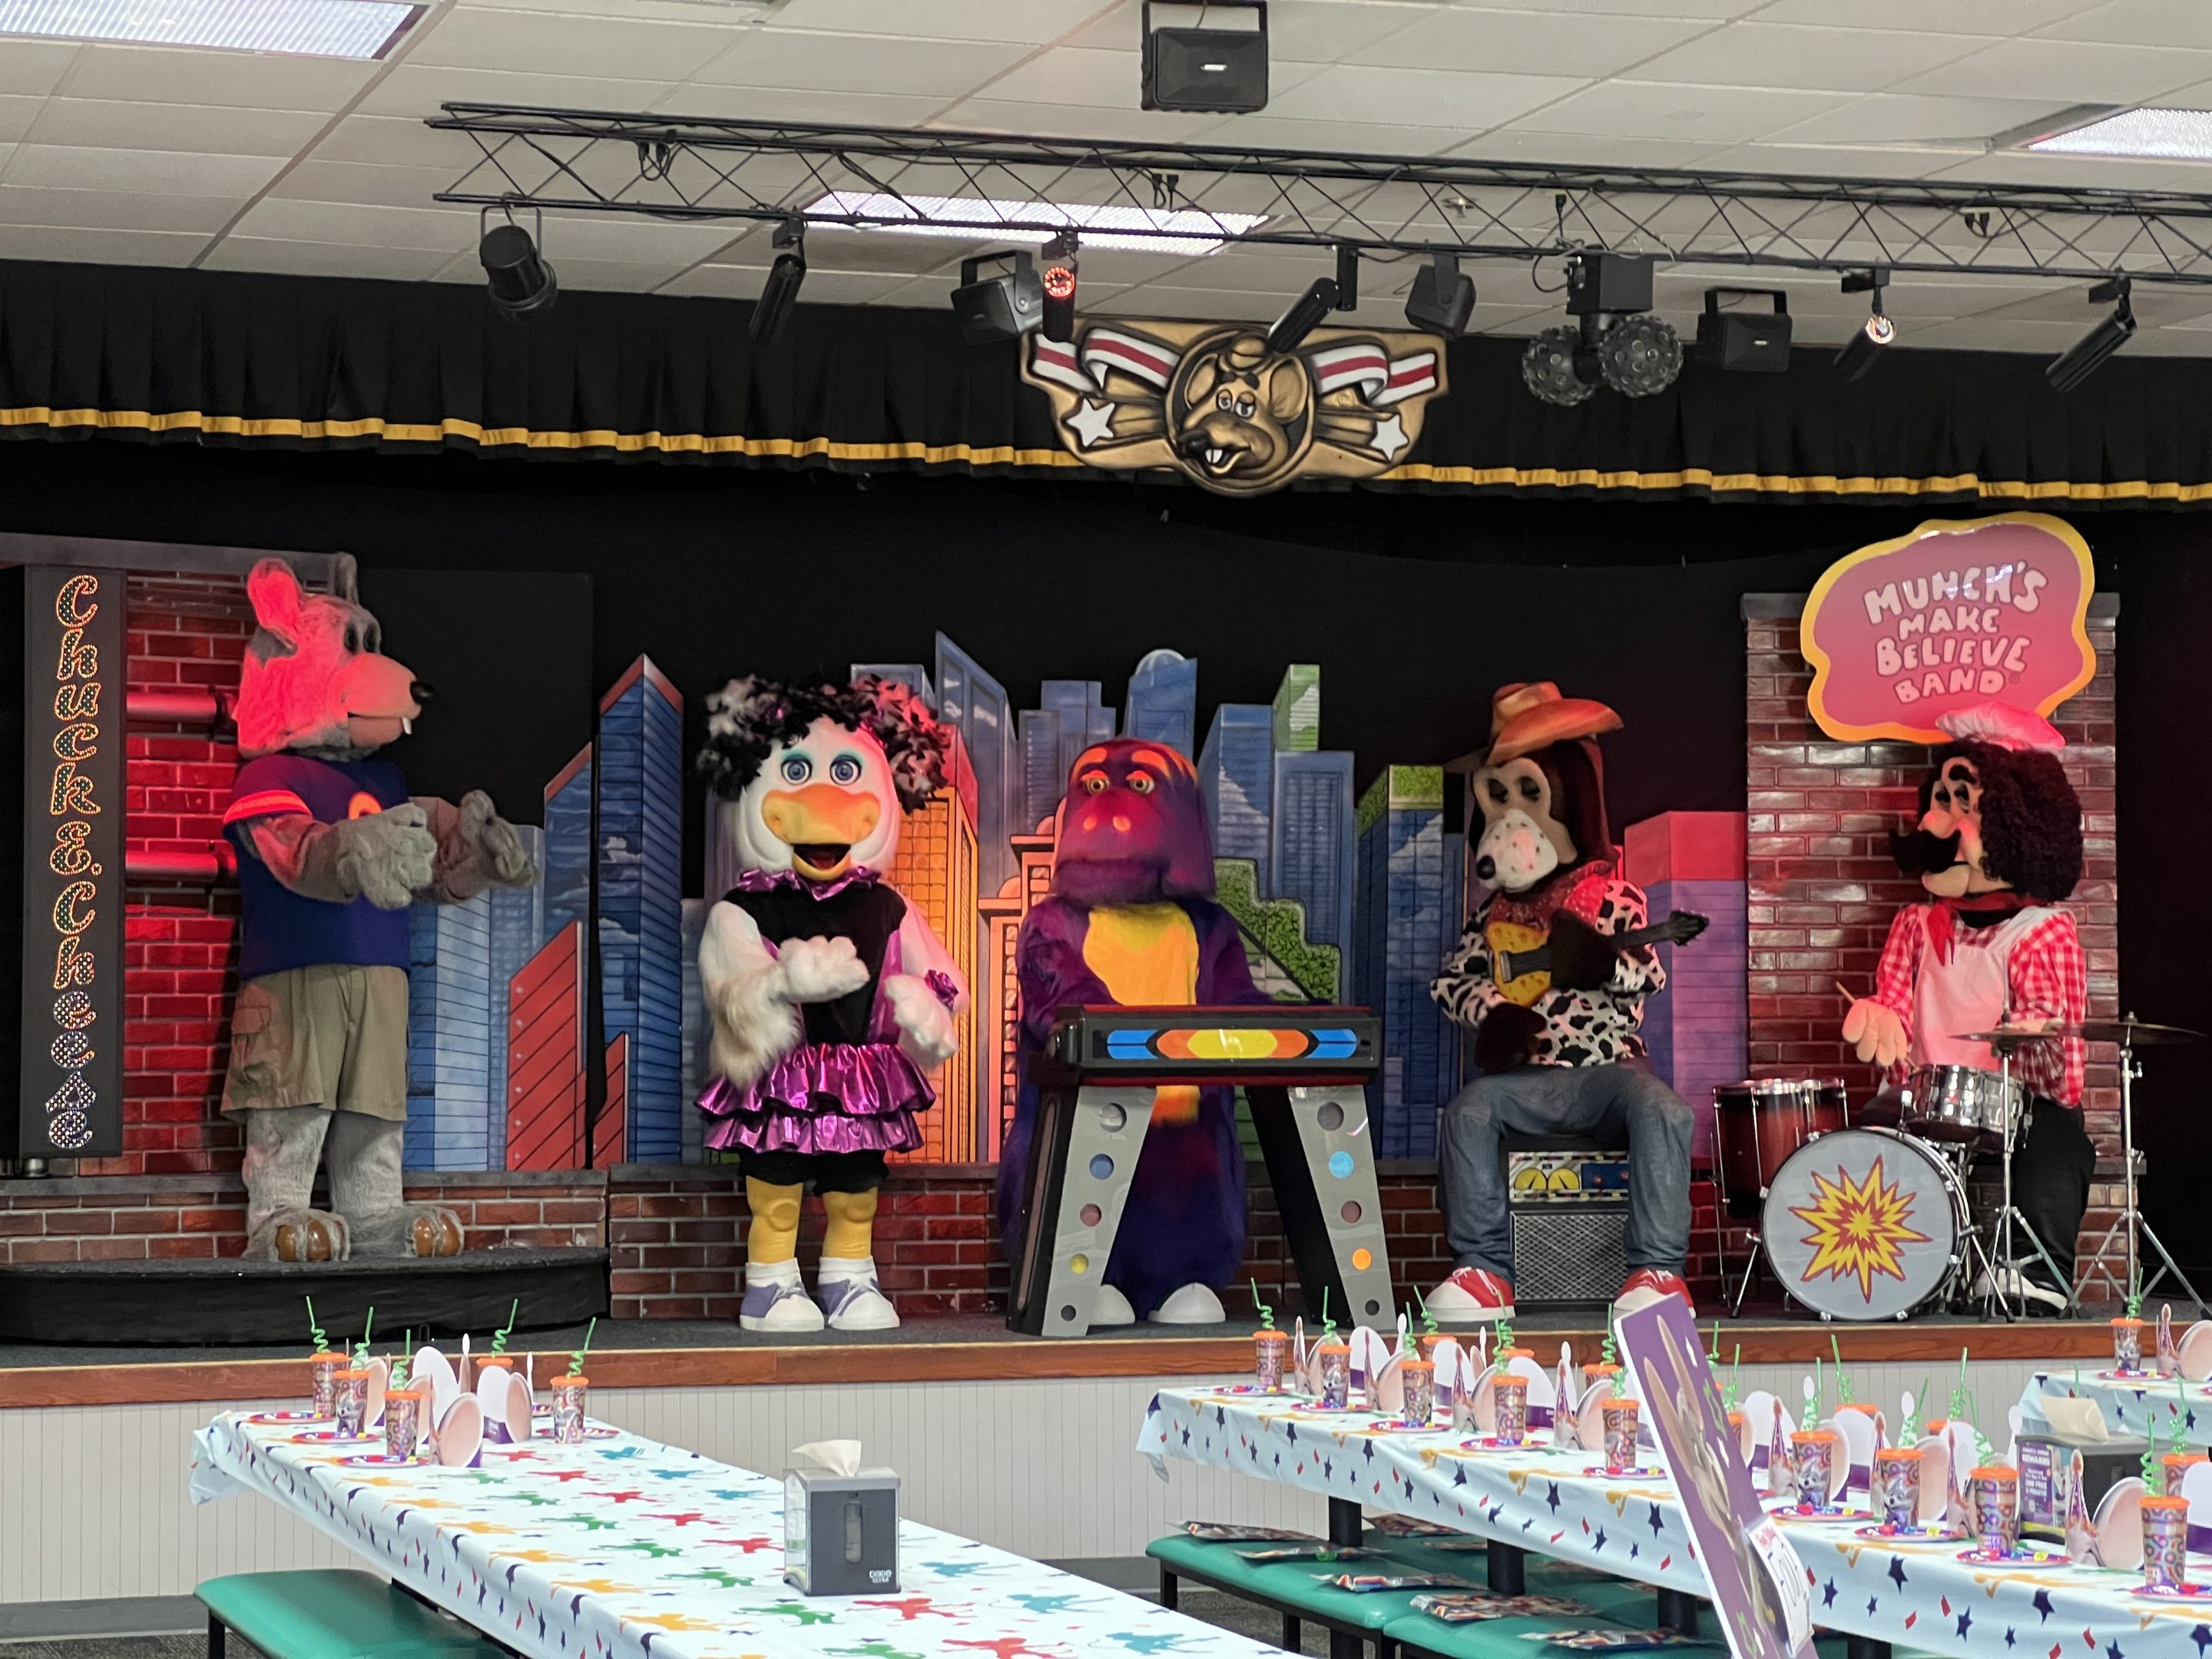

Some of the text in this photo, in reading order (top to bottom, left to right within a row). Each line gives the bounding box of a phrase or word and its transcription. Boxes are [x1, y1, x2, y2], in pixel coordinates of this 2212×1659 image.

[1863, 561, 2048, 624] MUNCH'S
[1899, 605, 2001, 641] MAKE
[1876, 636, 2032, 677] BELIEVE
[1893, 667, 2006, 704] BAND
